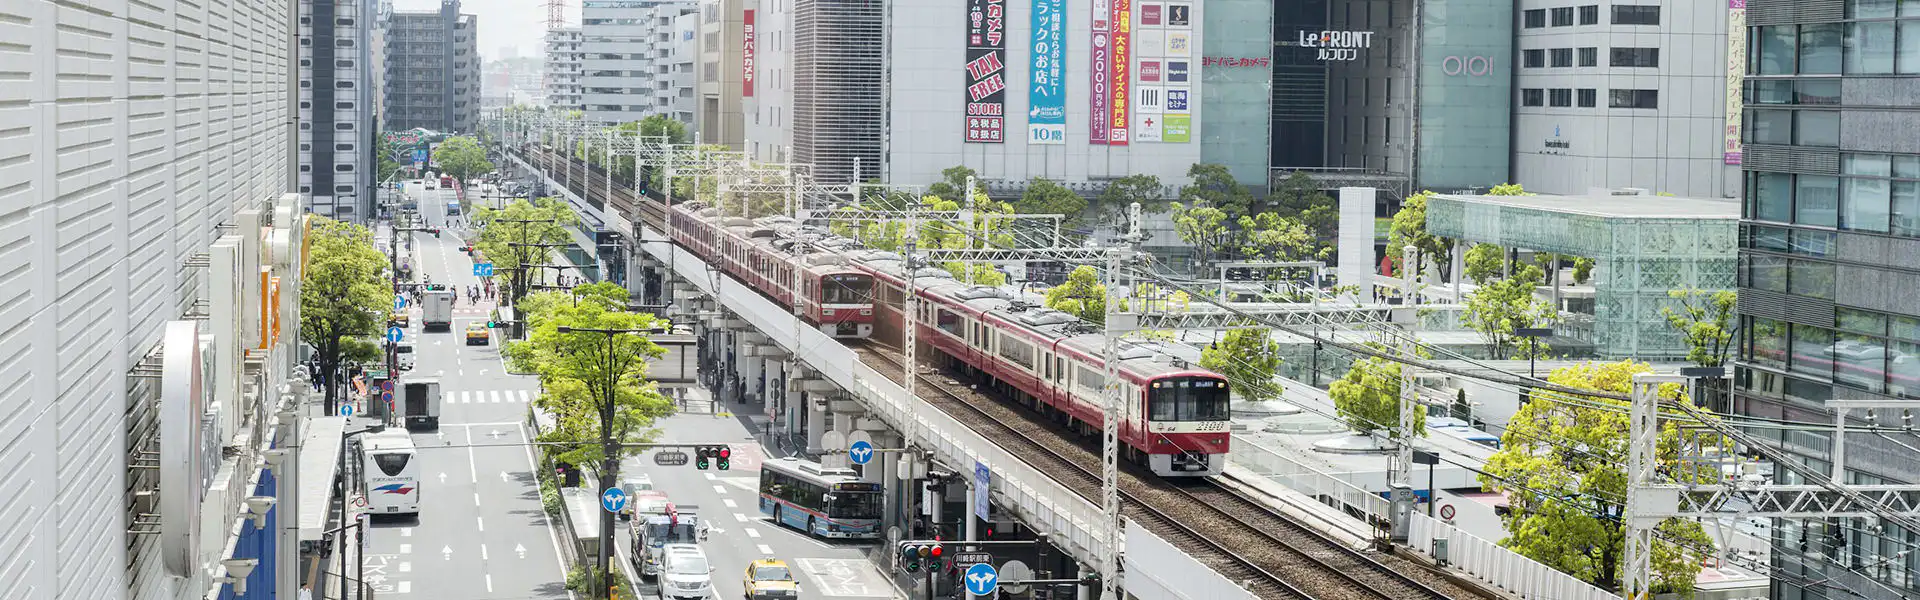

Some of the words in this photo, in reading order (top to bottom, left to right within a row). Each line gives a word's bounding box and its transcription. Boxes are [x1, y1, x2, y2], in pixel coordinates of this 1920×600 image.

[987, 0, 1002, 46] カメラ
[1300, 30, 1318, 47] Le
[1320, 30, 1374, 48] FRONT
[744, 24, 753, 81] ヨドバシカメラ
[1202, 56, 1269, 67] ヨドバシカメラ
[1317, 48, 1357, 60] ルフロン
[966, 50, 1004, 81] TAX
[968, 73, 1005, 102] FREE
[1114, 35, 1126, 128] 大きいサイズの専門店
[968, 103, 1002, 115] STORE
[1169, 100, 1187, 108] セミナー
[1113, 131, 1125, 140] 5F
